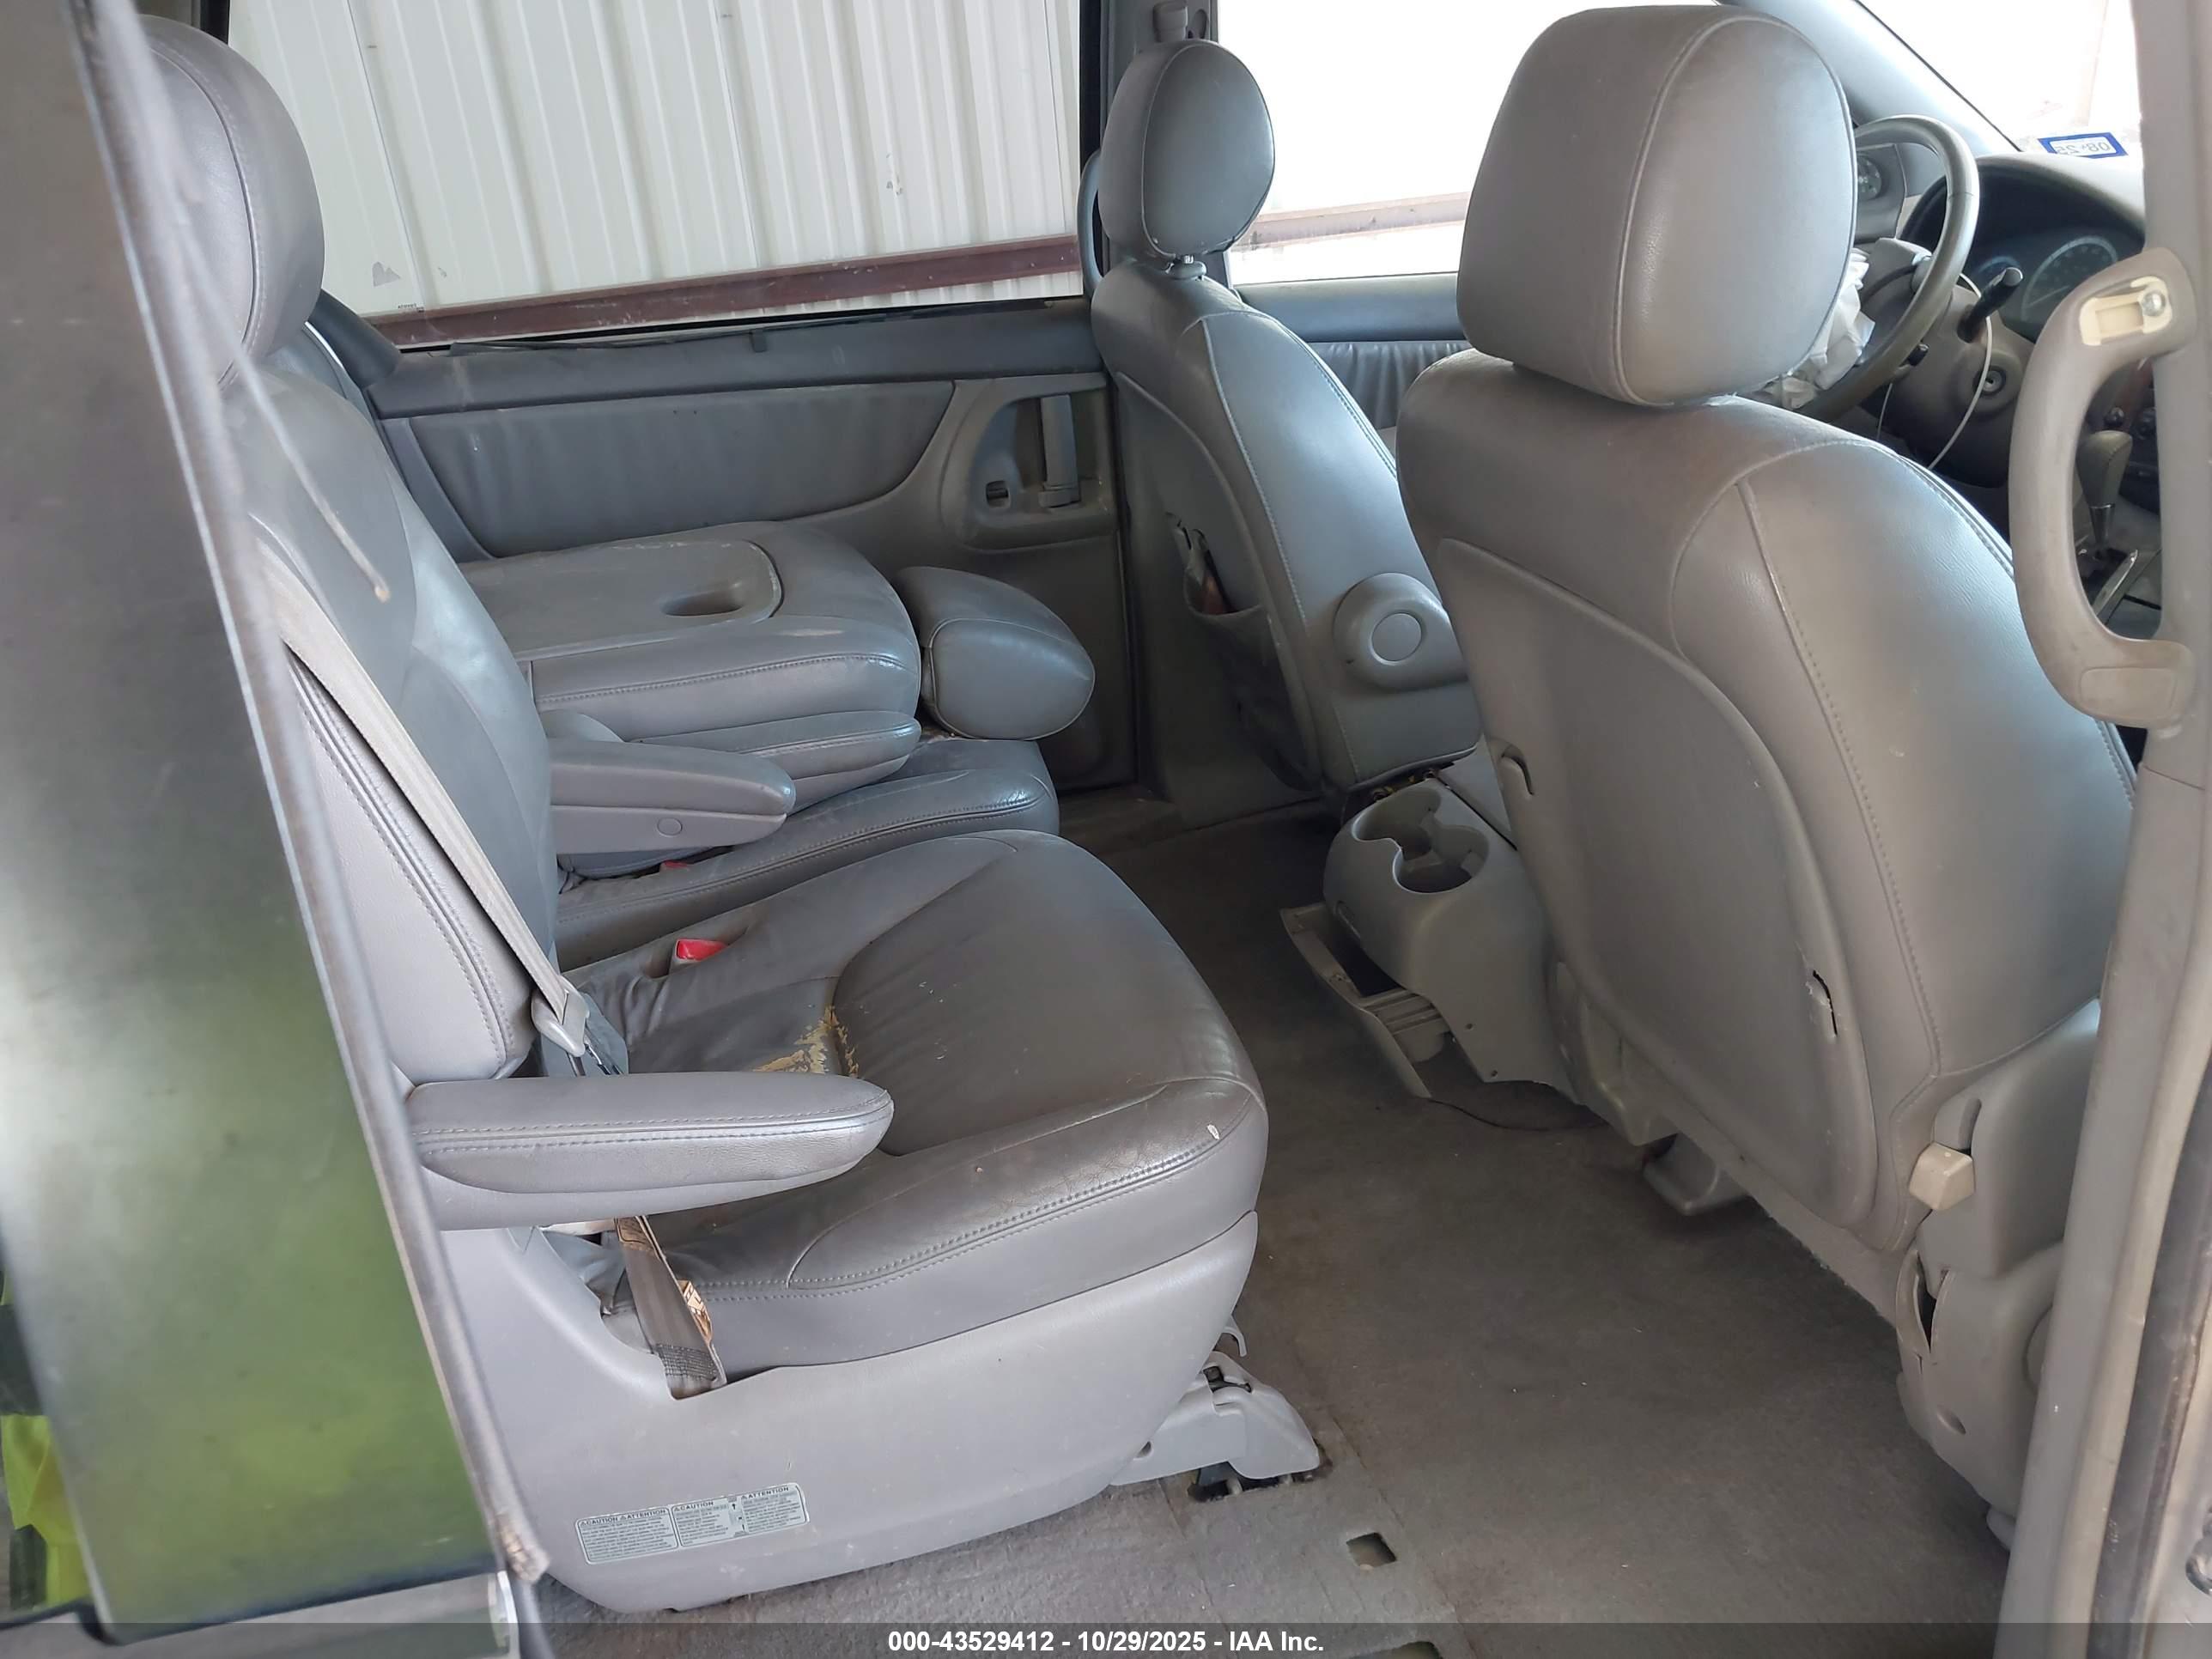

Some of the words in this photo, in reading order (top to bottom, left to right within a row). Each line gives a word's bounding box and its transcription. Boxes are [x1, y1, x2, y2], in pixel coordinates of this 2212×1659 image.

[748, 1486, 789, 1498] ATTENTION
[680, 1501, 714, 1511] CAUTION
[586, 1516, 618, 1526] CAUTION
[627, 1509, 665, 1519] ATTENTION
